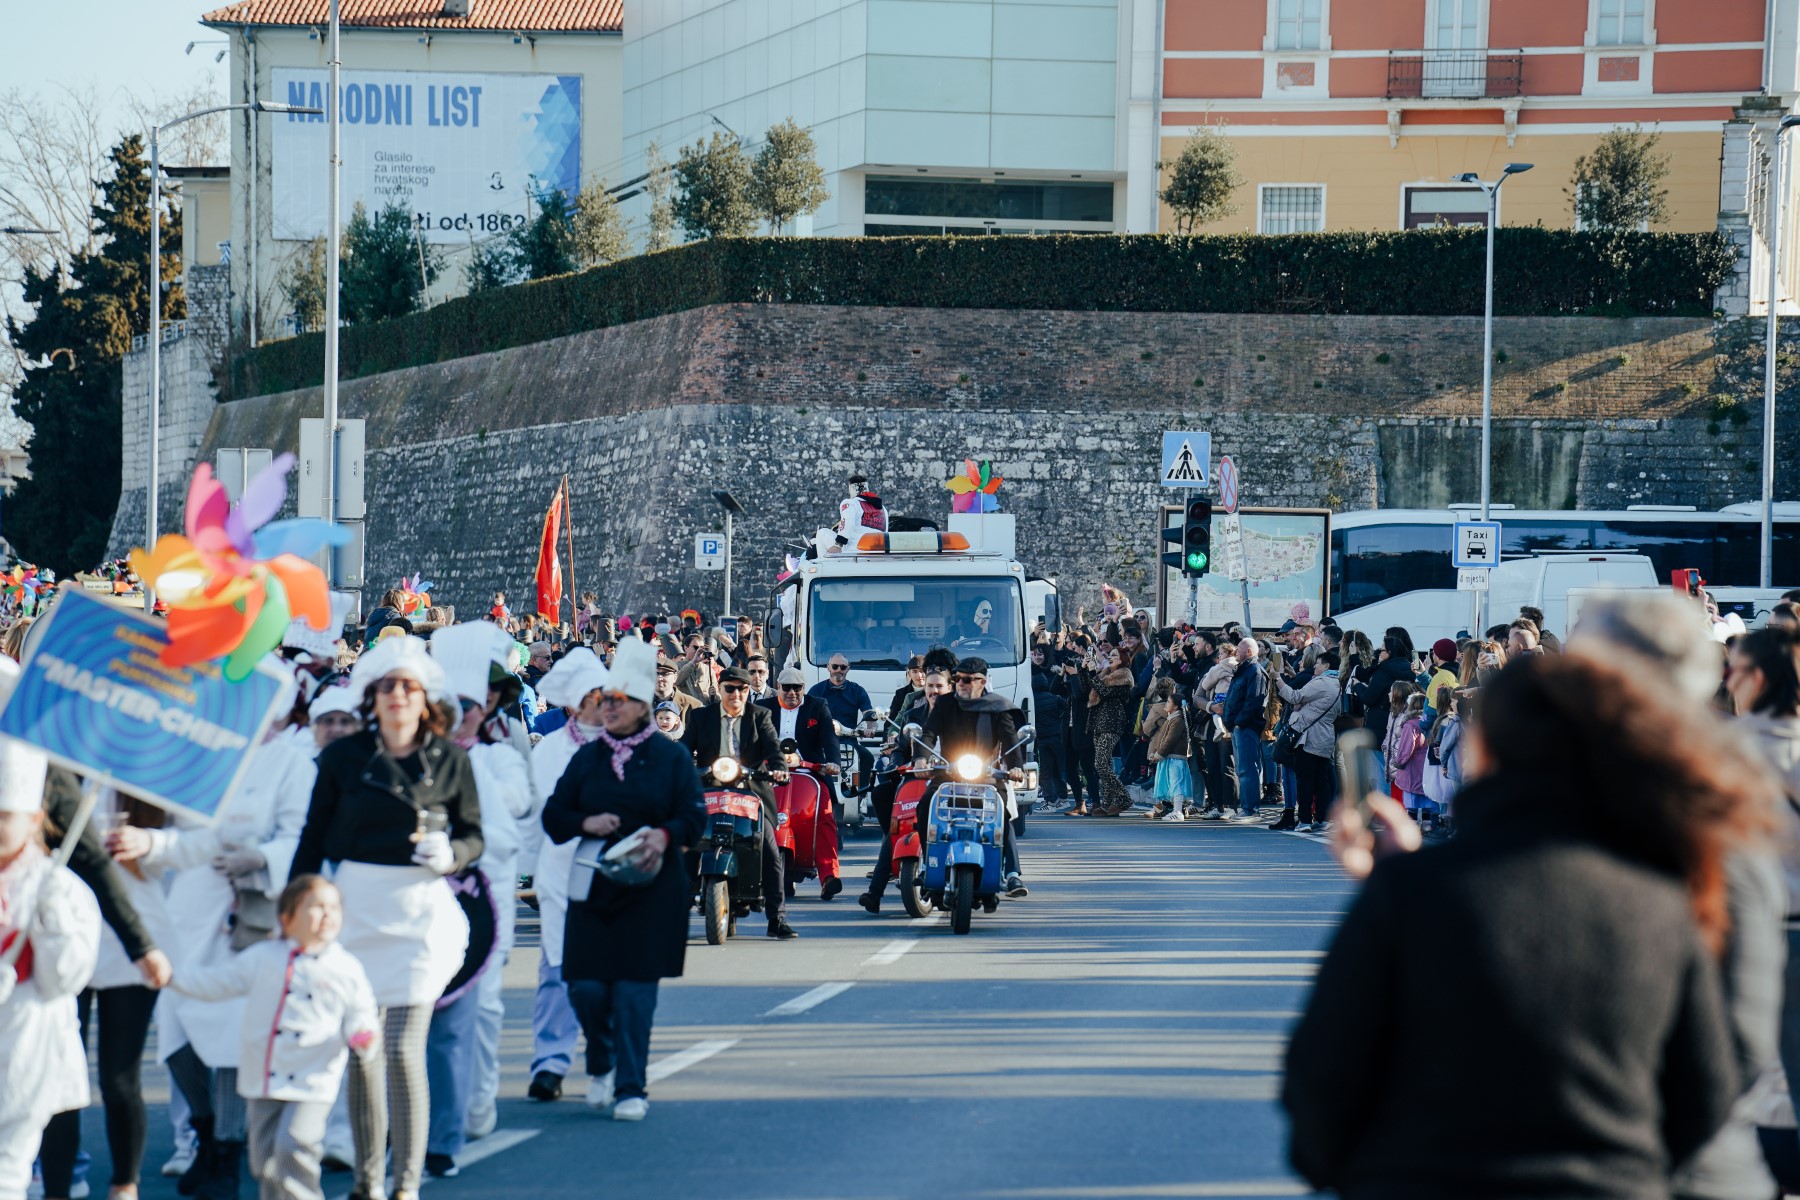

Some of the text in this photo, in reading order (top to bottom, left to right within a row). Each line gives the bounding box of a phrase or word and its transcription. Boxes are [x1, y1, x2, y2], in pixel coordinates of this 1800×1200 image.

[428, 85, 482, 127] LIST
[374, 151, 413, 162] Glasilo
[374, 163, 436, 174] za interese
[374, 174, 429, 187] hrvatskog
[374, 185, 413, 196] naroda
[439, 213, 468, 231] od
[477, 214, 526, 232] 1862
[1467, 531, 1488, 539] Taxi
[706, 541, 716, 554] P
[1466, 574, 1485, 585] mjesta
